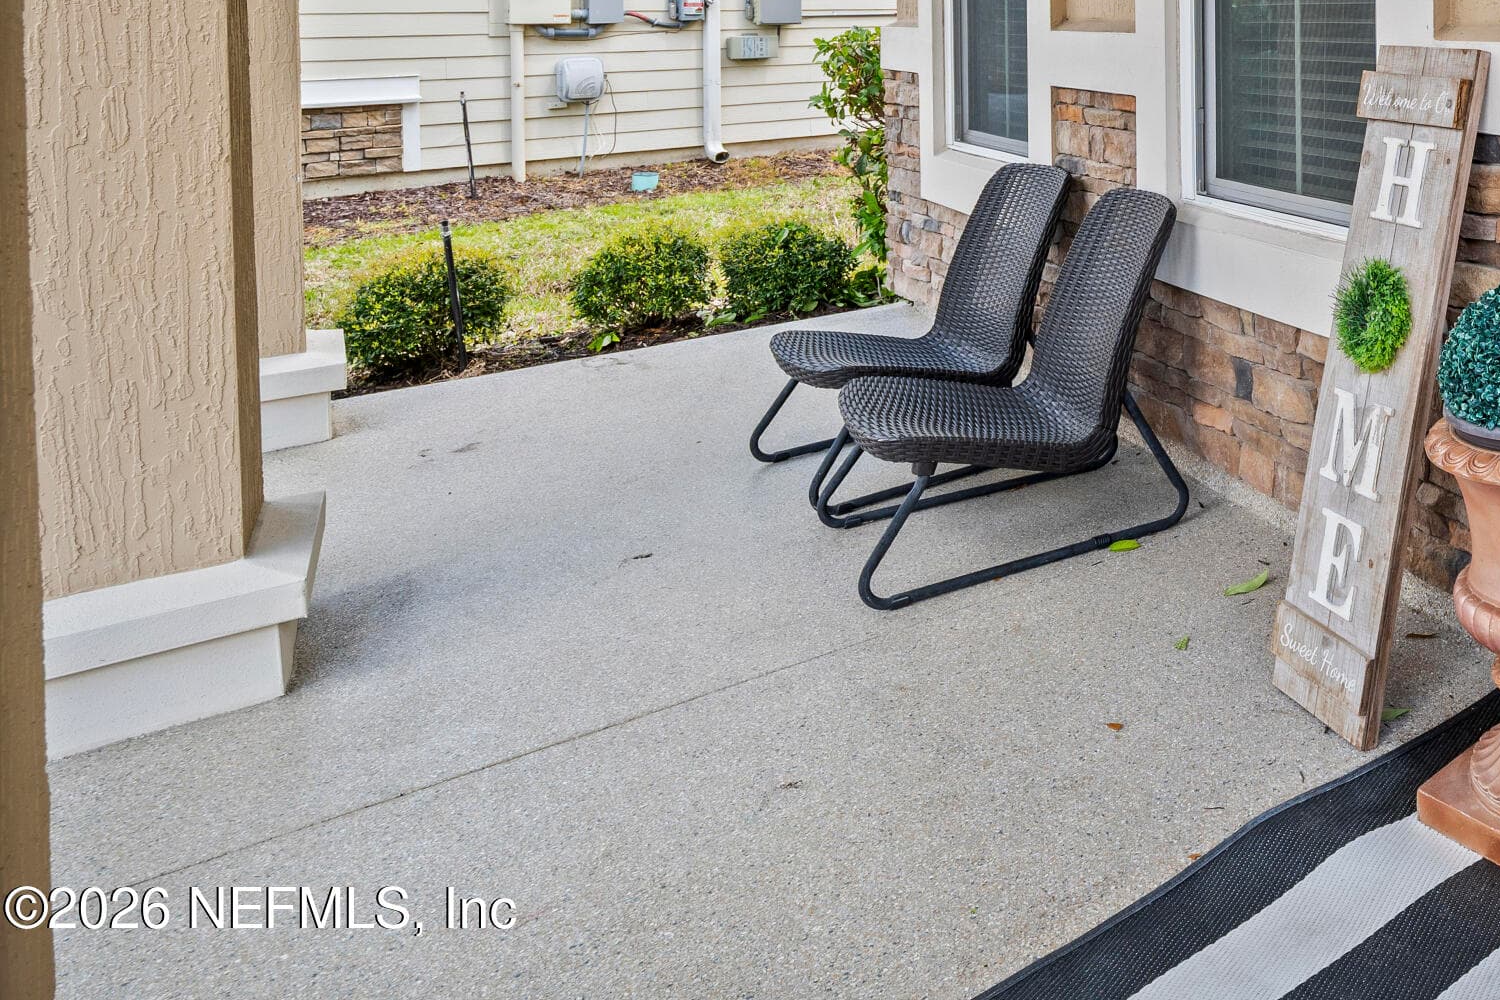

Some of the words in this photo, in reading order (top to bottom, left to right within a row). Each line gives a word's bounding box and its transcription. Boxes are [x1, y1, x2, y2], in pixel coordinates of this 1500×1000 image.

[1419, 92, 1433, 112] to
[1280, 623, 1318, 666] Sweet
[1320, 649, 1356, 692] Home
